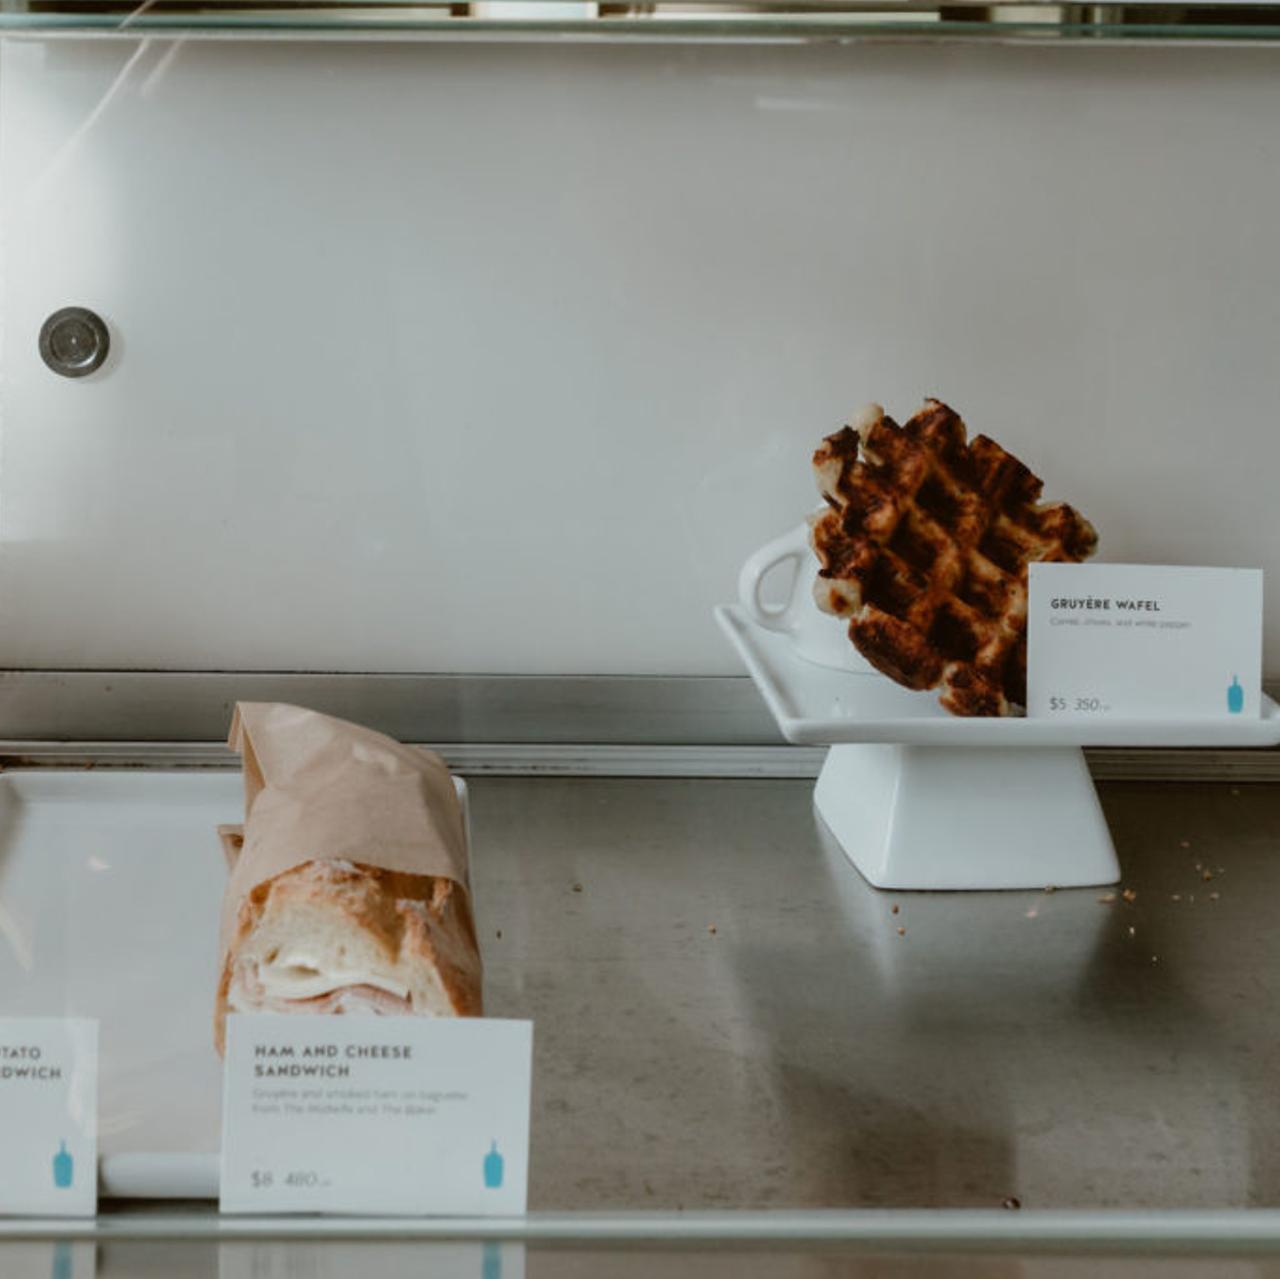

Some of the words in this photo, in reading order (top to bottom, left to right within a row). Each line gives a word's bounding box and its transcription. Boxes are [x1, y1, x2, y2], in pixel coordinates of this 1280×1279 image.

[1051, 596, 1111, 610] GRUYÈRE
[1117, 601, 1160, 612] WAFEL
[1050, 697, 1067, 711] $5
[1074, 698, 1098, 711] 350
[255, 1045, 294, 1059] HAM
[302, 1045, 338, 1059] AND
[345, 1045, 412, 1059] CHEESE
[254, 1065, 350, 1078] SANDWICH
